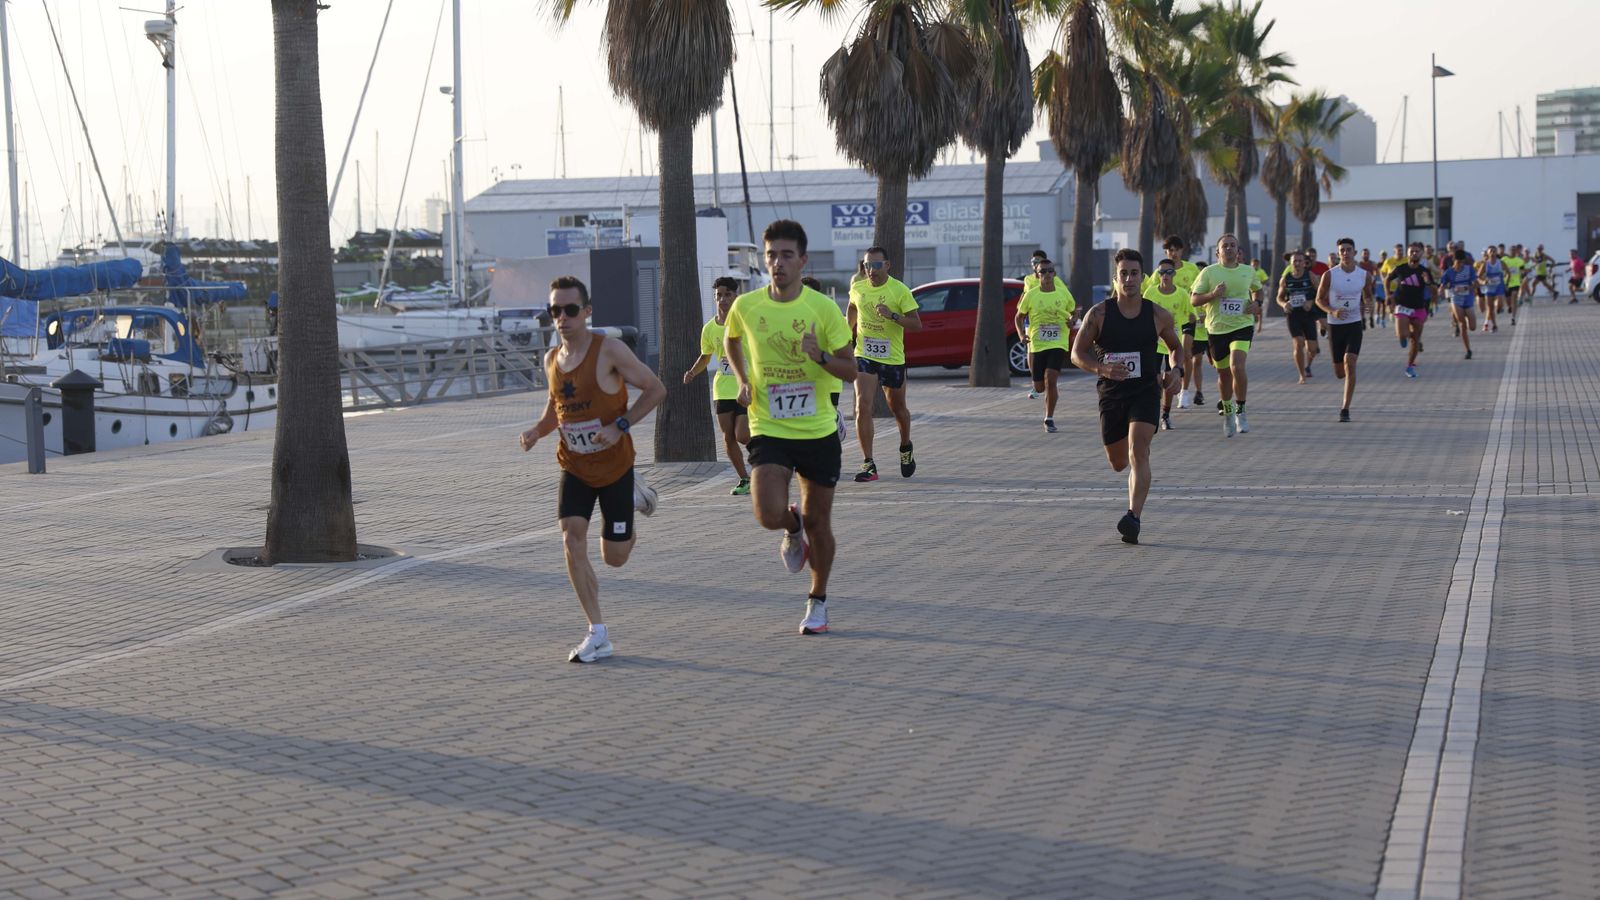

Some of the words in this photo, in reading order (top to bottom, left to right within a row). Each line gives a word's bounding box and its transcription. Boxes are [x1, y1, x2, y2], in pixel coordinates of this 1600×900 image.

[837, 202, 923, 216] VOO
[935, 201, 1031, 220] eliasanc
[834, 214, 927, 227] PEA
[833, 230, 864, 241] Marine
[1223, 303, 1241, 312] 162
[1343, 300, 1350, 308] 4
[1042, 330, 1058, 338] 795
[866, 343, 887, 354] 333
[774, 393, 809, 411] 177
